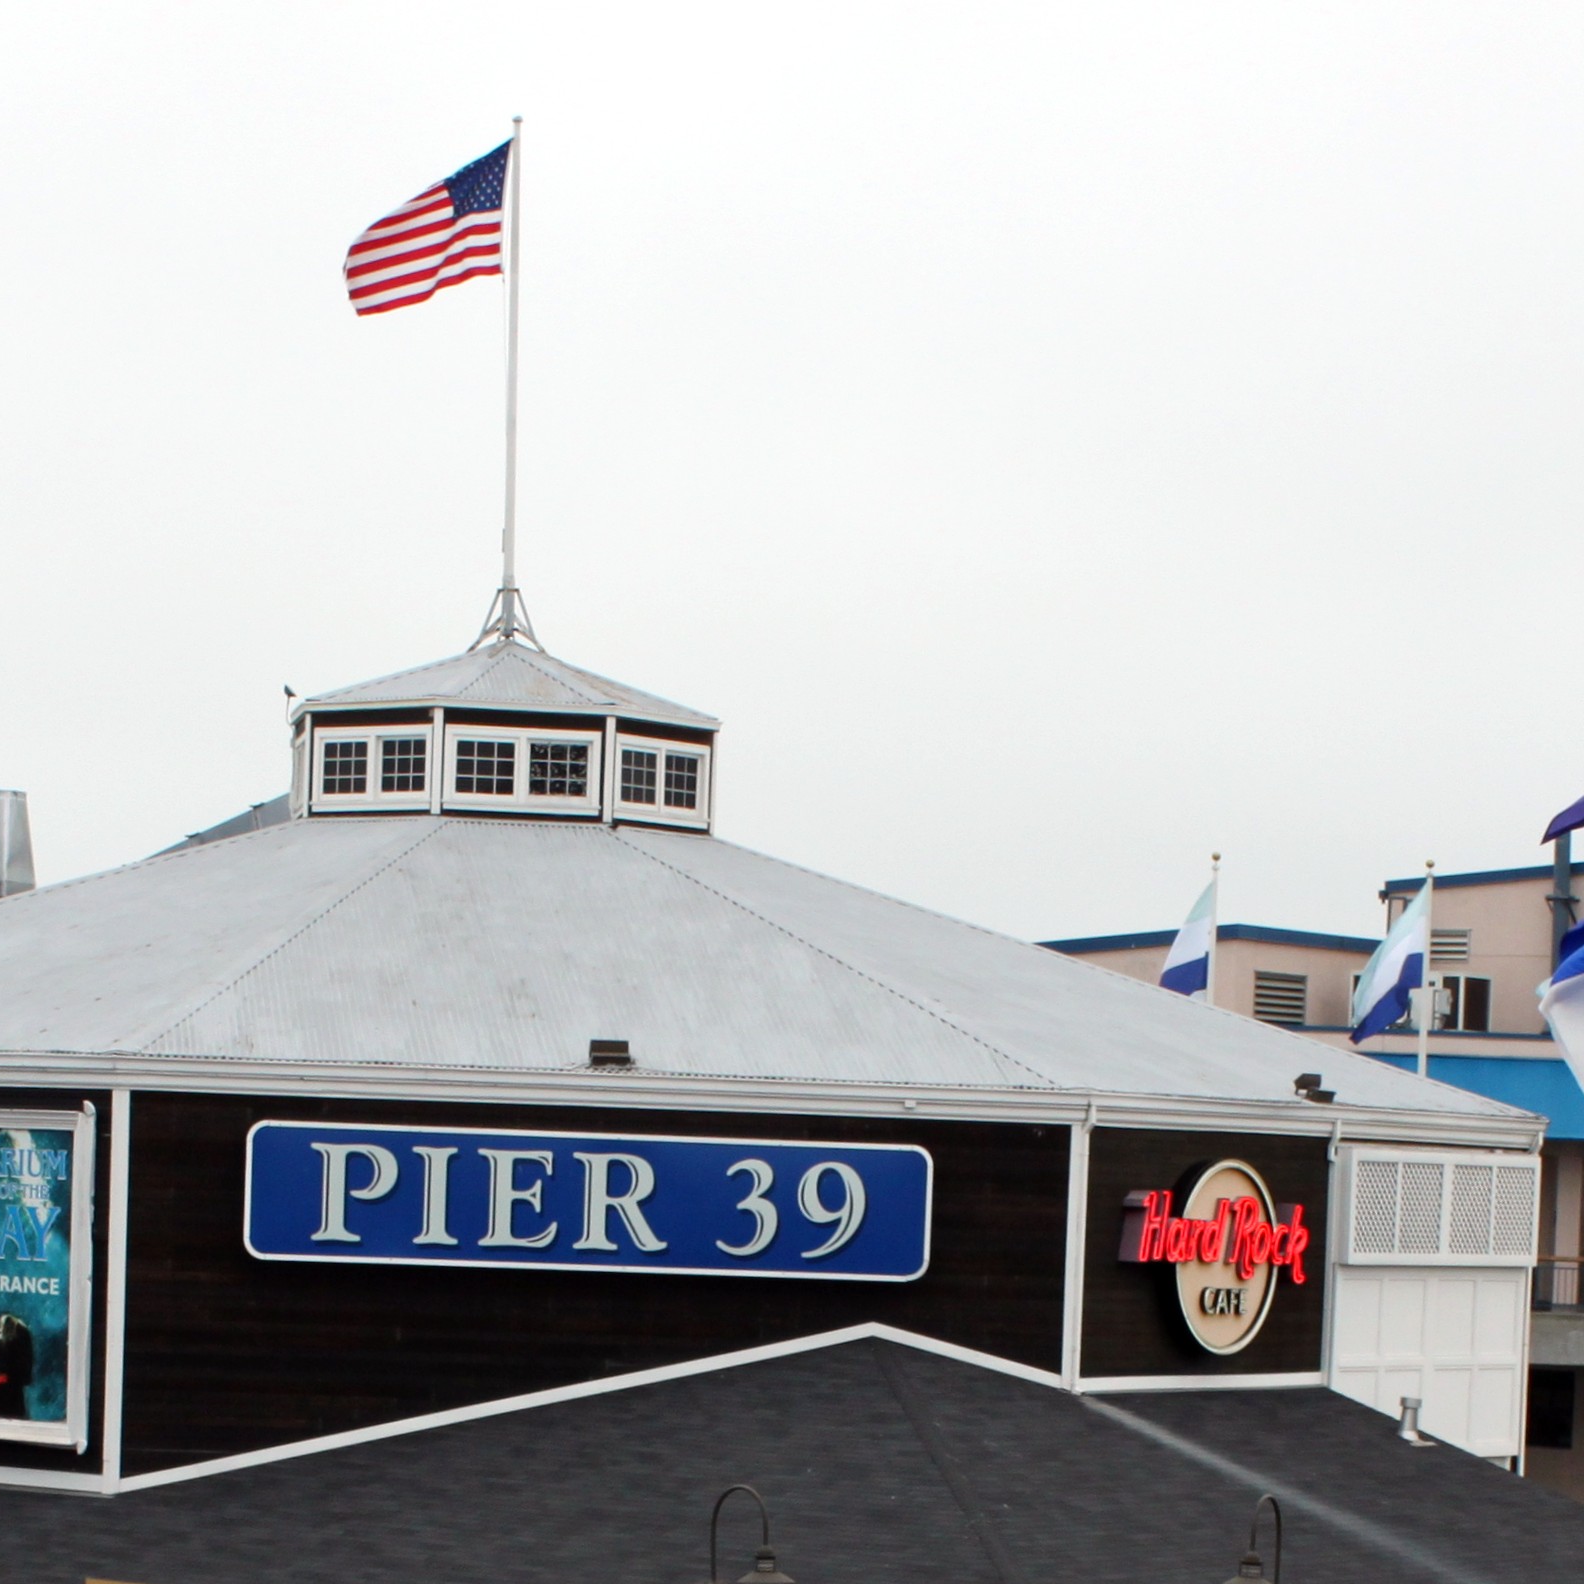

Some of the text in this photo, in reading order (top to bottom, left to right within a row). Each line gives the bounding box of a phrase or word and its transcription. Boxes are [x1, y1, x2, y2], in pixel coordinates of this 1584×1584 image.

[21, 1184, 50, 1199] THE
[310, 1141, 867, 1258] PIER 39
[1138, 1190, 1309, 1285] Hard Rock
[1200, 1286, 1248, 1317] CAFE
